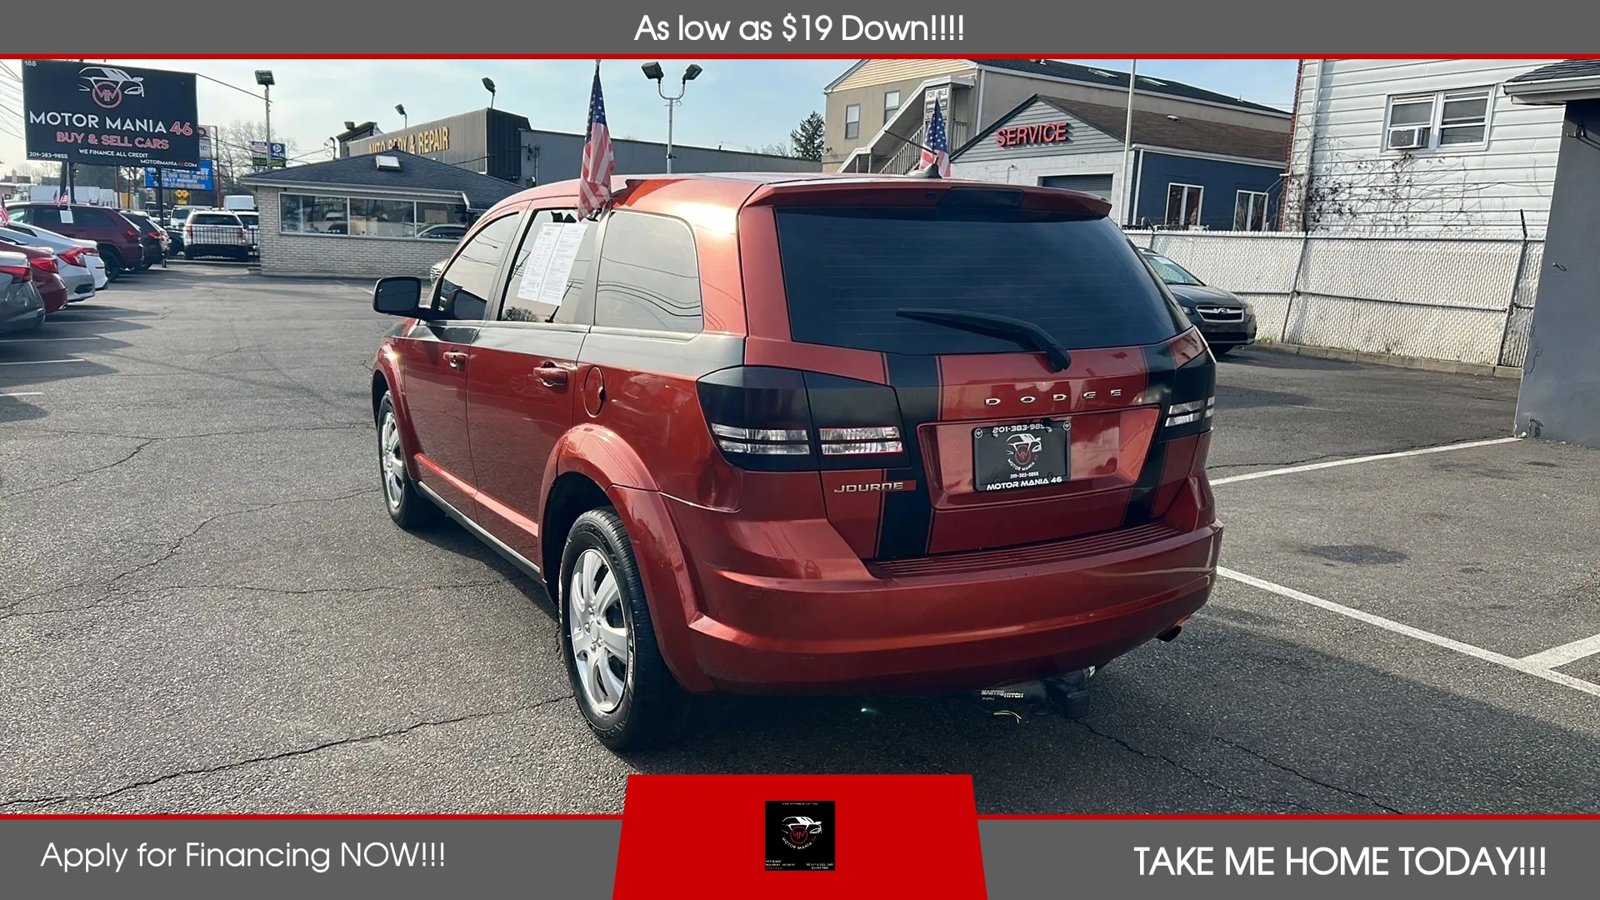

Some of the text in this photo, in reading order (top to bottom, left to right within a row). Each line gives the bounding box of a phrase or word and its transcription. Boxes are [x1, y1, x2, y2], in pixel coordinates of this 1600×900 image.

[29, 110, 193, 137] MOTOR MANIA 46
[56, 131, 170, 150] BUY & SELL CARS
[409, 134, 416, 154] &
[418, 126, 450, 155] REPAIR
[995, 121, 1067, 148] SERVICE
[985, 388, 1122, 406] DODGE
[833, 481, 904, 493] JOURNE
[986, 476, 1063, 491] MOTOR MANIA 46
